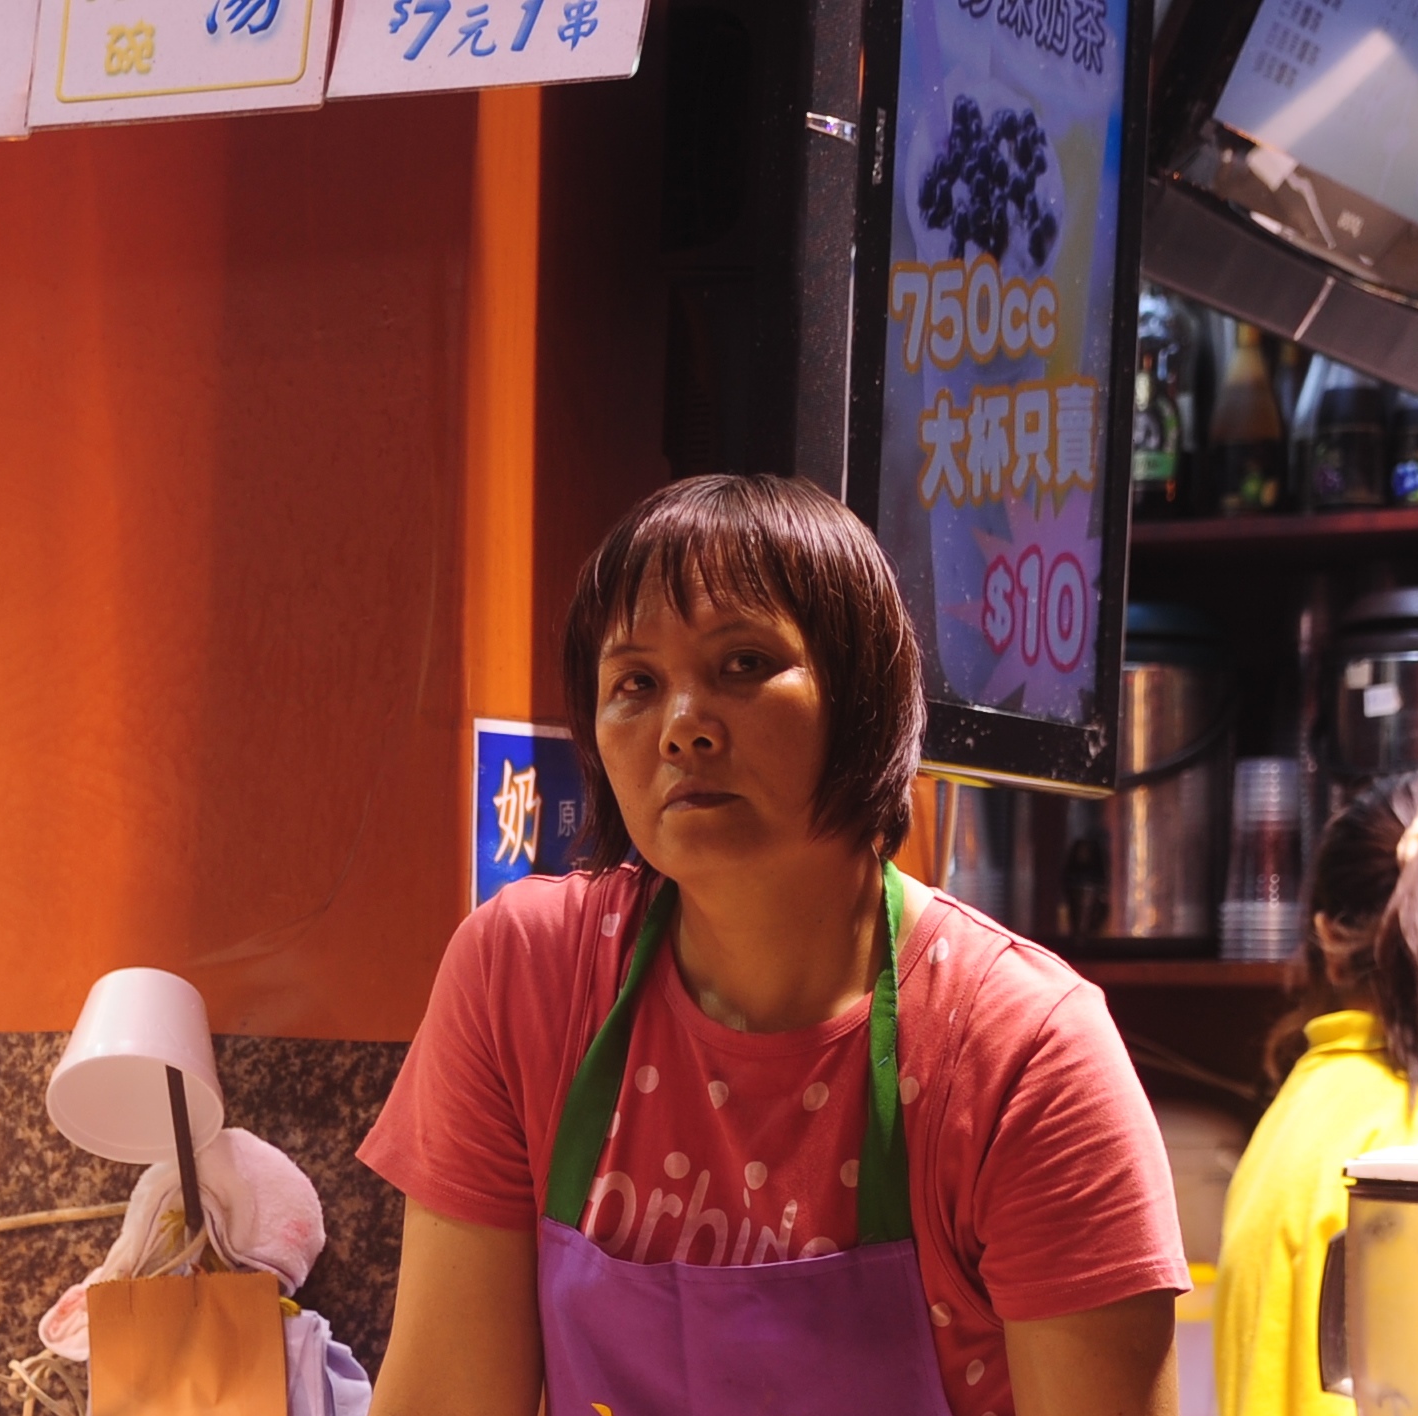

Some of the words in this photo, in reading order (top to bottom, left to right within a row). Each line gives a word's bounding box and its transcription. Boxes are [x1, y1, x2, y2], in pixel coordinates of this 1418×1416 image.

[958, 0, 1107, 74] 奶茶
[890, 257, 1058, 372] 750cc
[918, 378, 1099, 507] 大杯只賣
[983, 543, 1087, 674] $10
[492, 758, 542, 866] 奶
